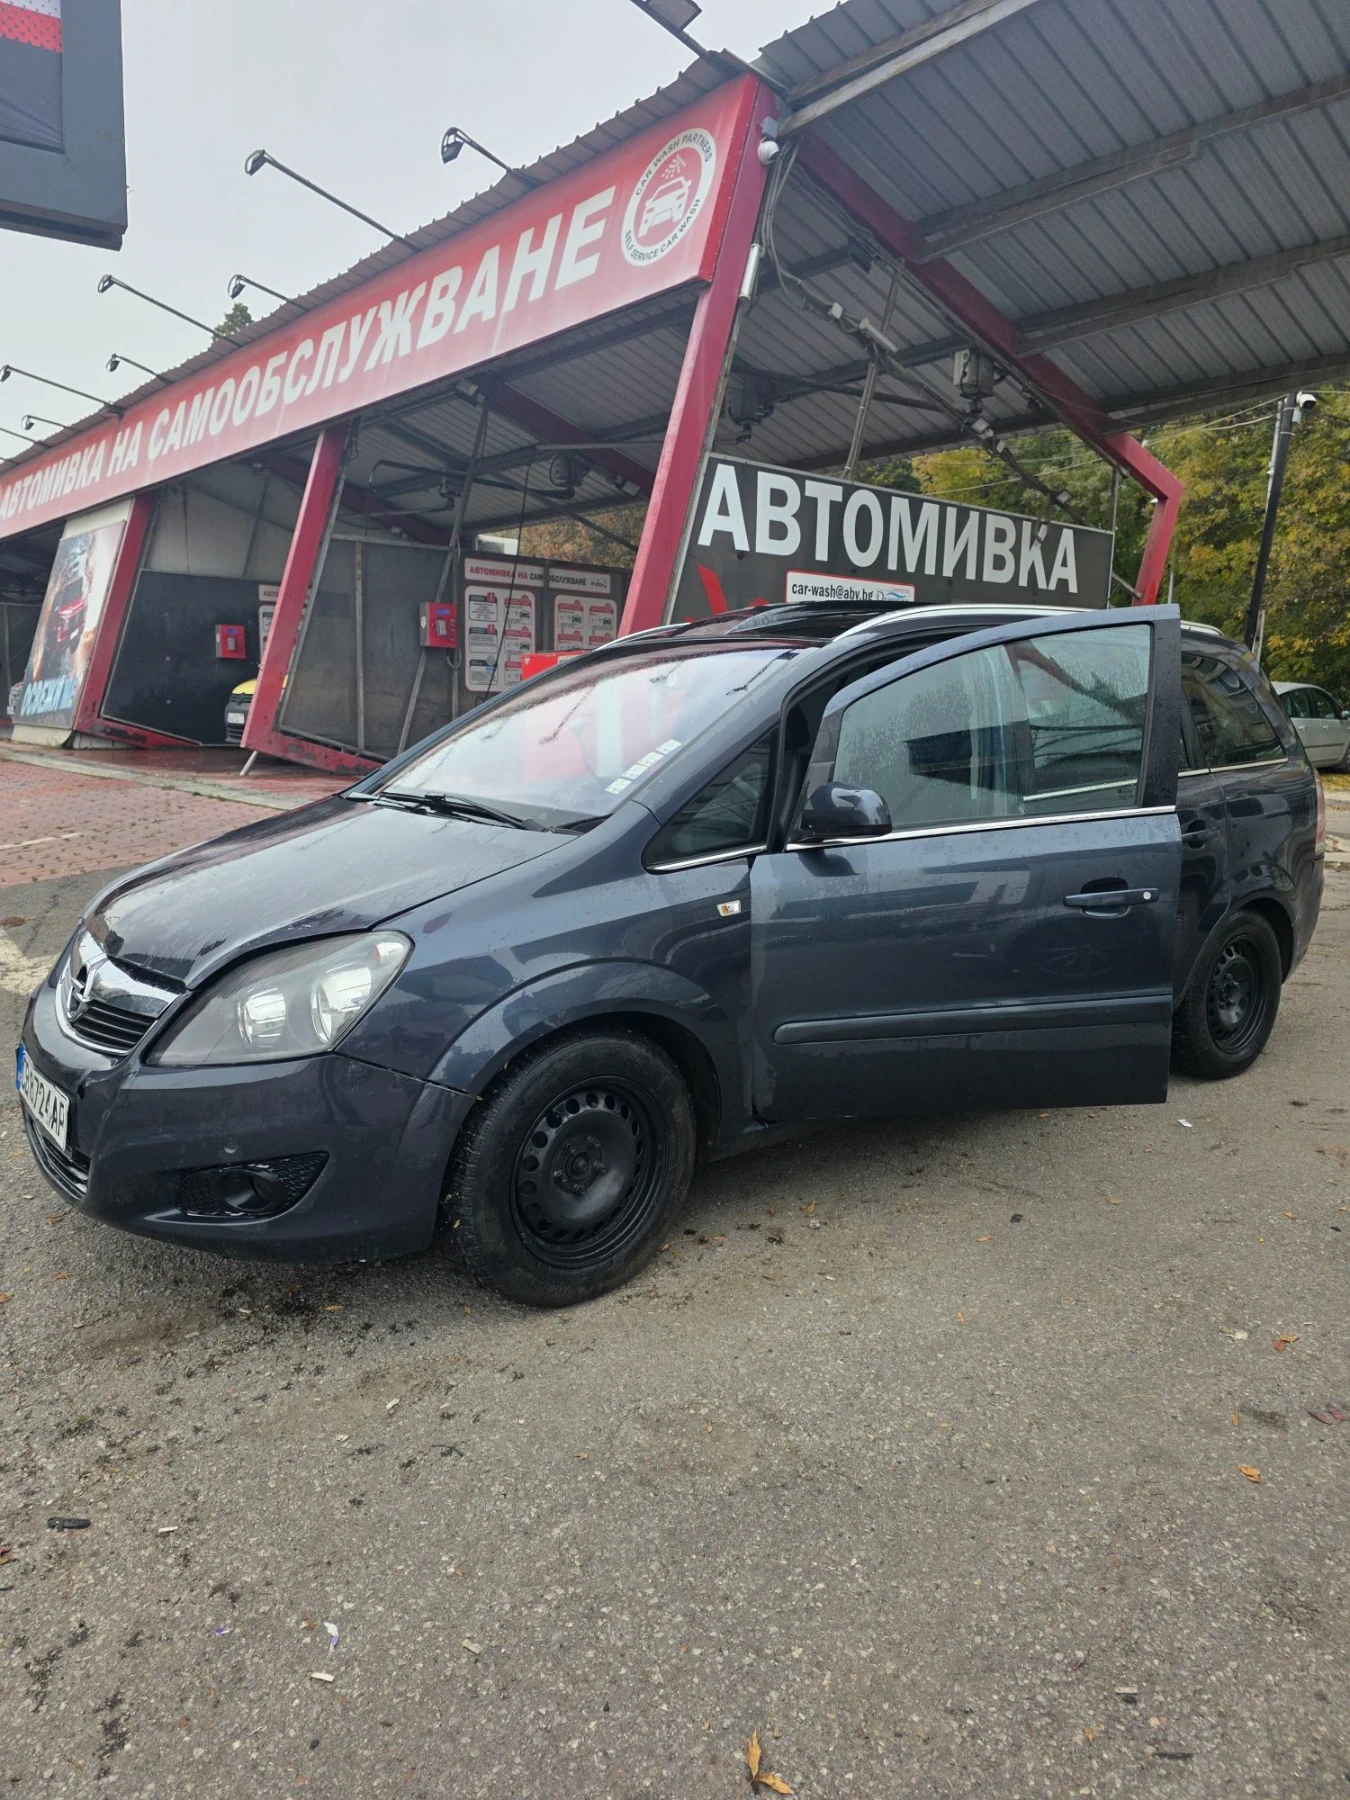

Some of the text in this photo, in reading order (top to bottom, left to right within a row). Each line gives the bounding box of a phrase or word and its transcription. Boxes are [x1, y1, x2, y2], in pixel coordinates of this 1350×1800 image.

[635, 132, 713, 197] CAR WASH PARTNERS
[625, 199, 701, 261] SELF SERVICE CAR WASH
[0, 185, 616, 521] АВТОМИВКА НА САМООБСЛУЖВАНЕ
[697, 462, 1079, 594] АВТОМИВКА
[517, 572, 528, 581] НА
[791, 583, 874, 601] car-wash@abv.bg
